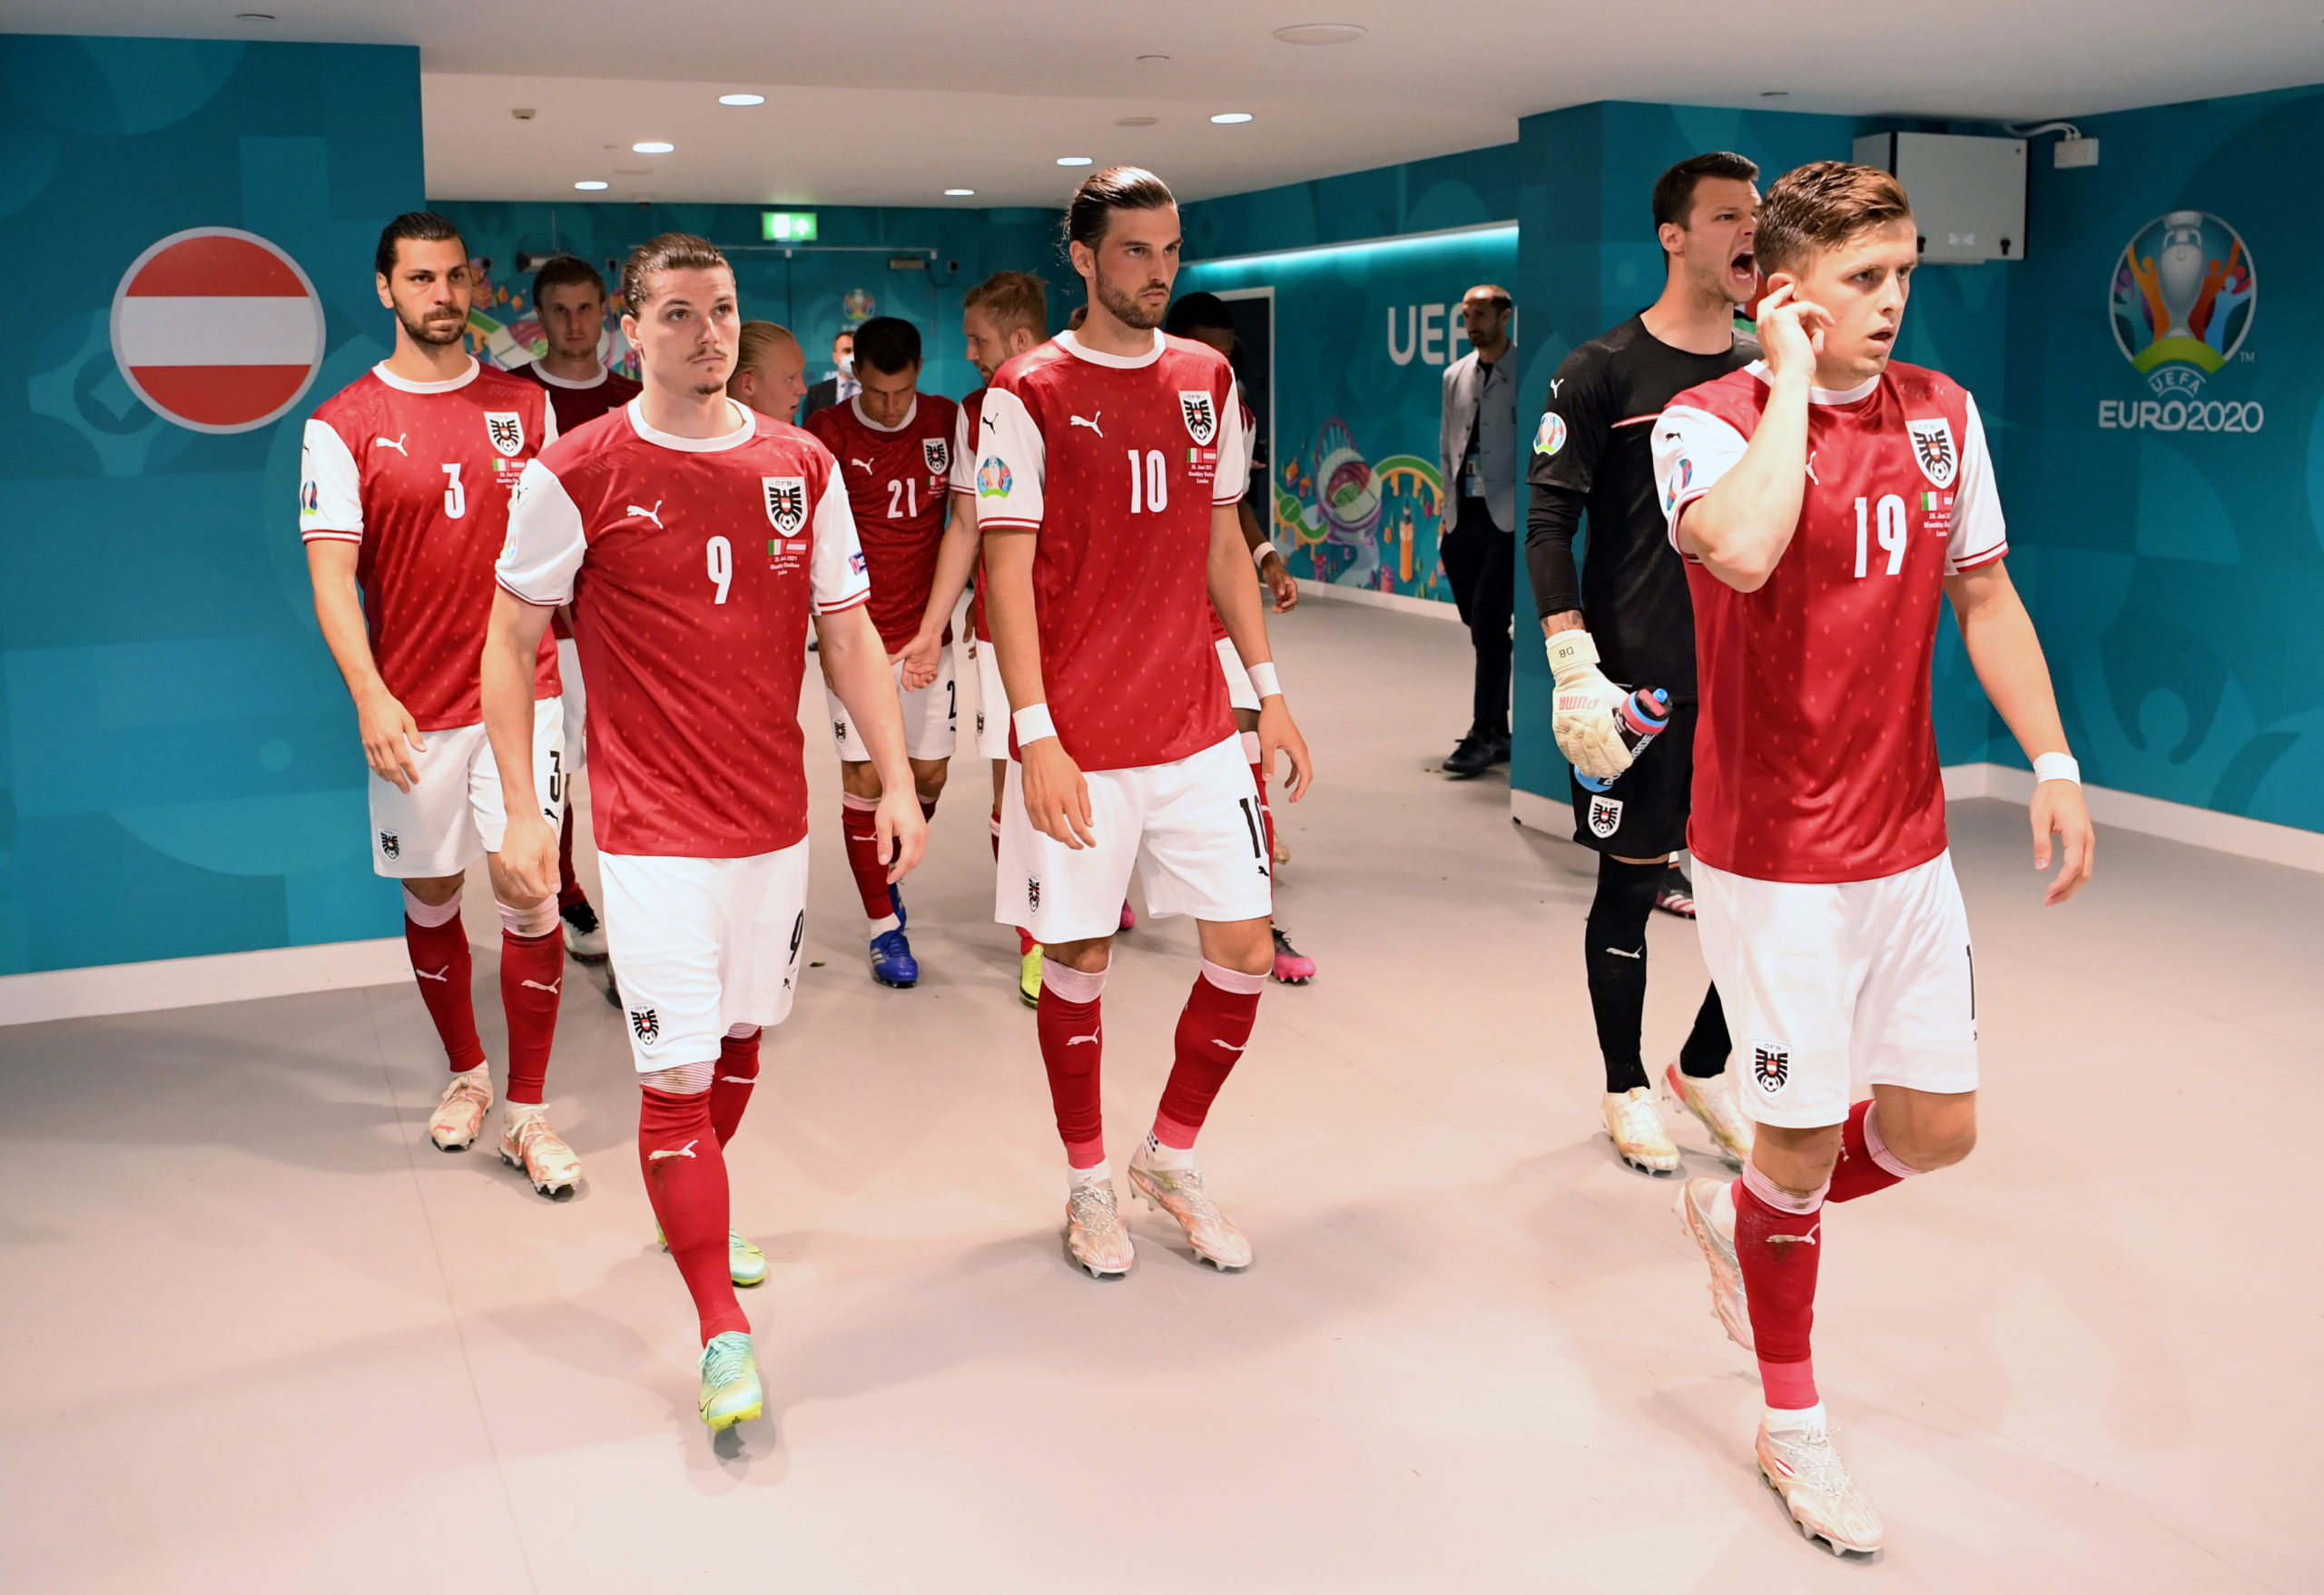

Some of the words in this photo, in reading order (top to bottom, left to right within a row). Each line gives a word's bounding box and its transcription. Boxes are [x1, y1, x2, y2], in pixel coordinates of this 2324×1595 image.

[1387, 303, 1471, 366] UEF
[2150, 370, 2201, 394] UEFA
[2098, 399, 2265, 433] EURO2020
[441, 463, 466, 519] 3
[887, 478, 918, 519] 21
[1128, 449, 1167, 514] 10
[1854, 494, 1907, 578] 19
[706, 536, 733, 605] 9
[1559, 645, 1574, 658] DB
[1558, 695, 1600, 711] PUMA
[549, 751, 561, 802] 3
[789, 908, 804, 965] 9
